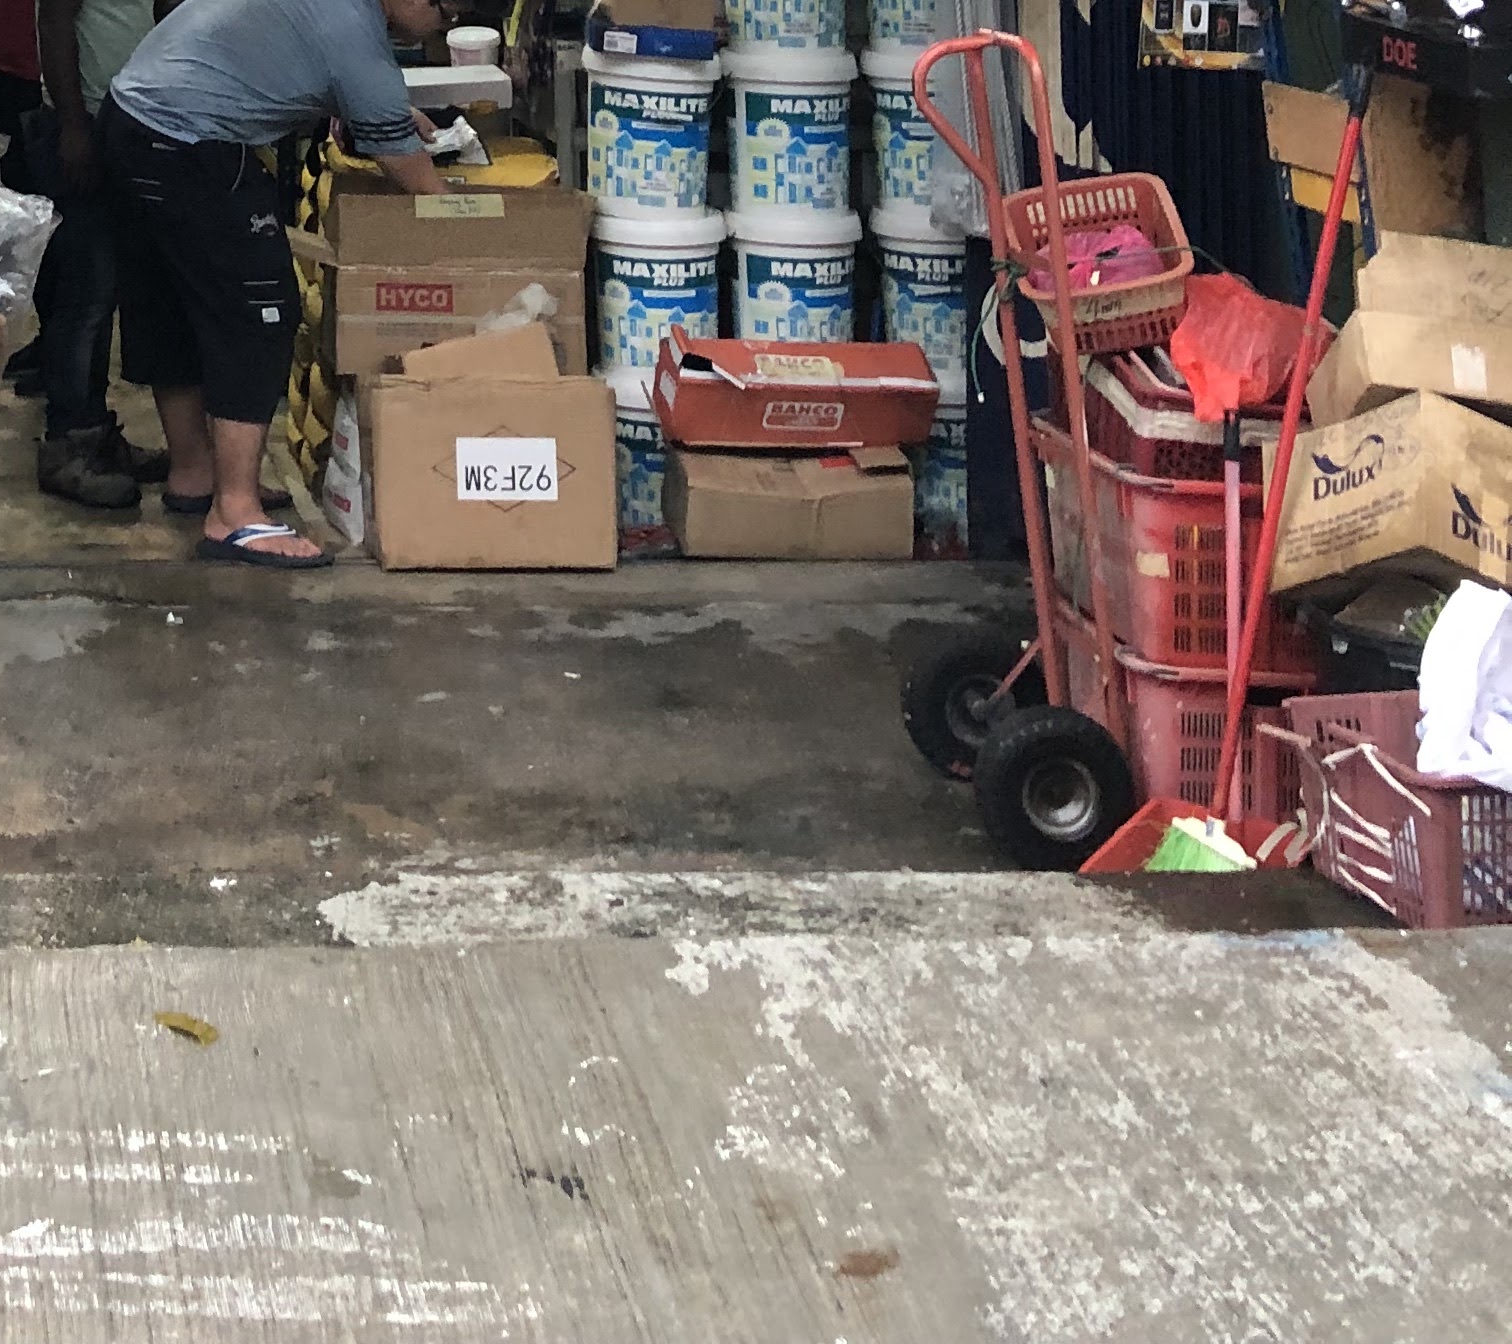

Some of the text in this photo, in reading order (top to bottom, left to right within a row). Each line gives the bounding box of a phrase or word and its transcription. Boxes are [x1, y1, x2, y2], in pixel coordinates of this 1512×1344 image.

[378, 286, 450, 308] HYCO
[464, 464, 553, 492] 92F3M
[1313, 464, 1376, 501] Dulux
